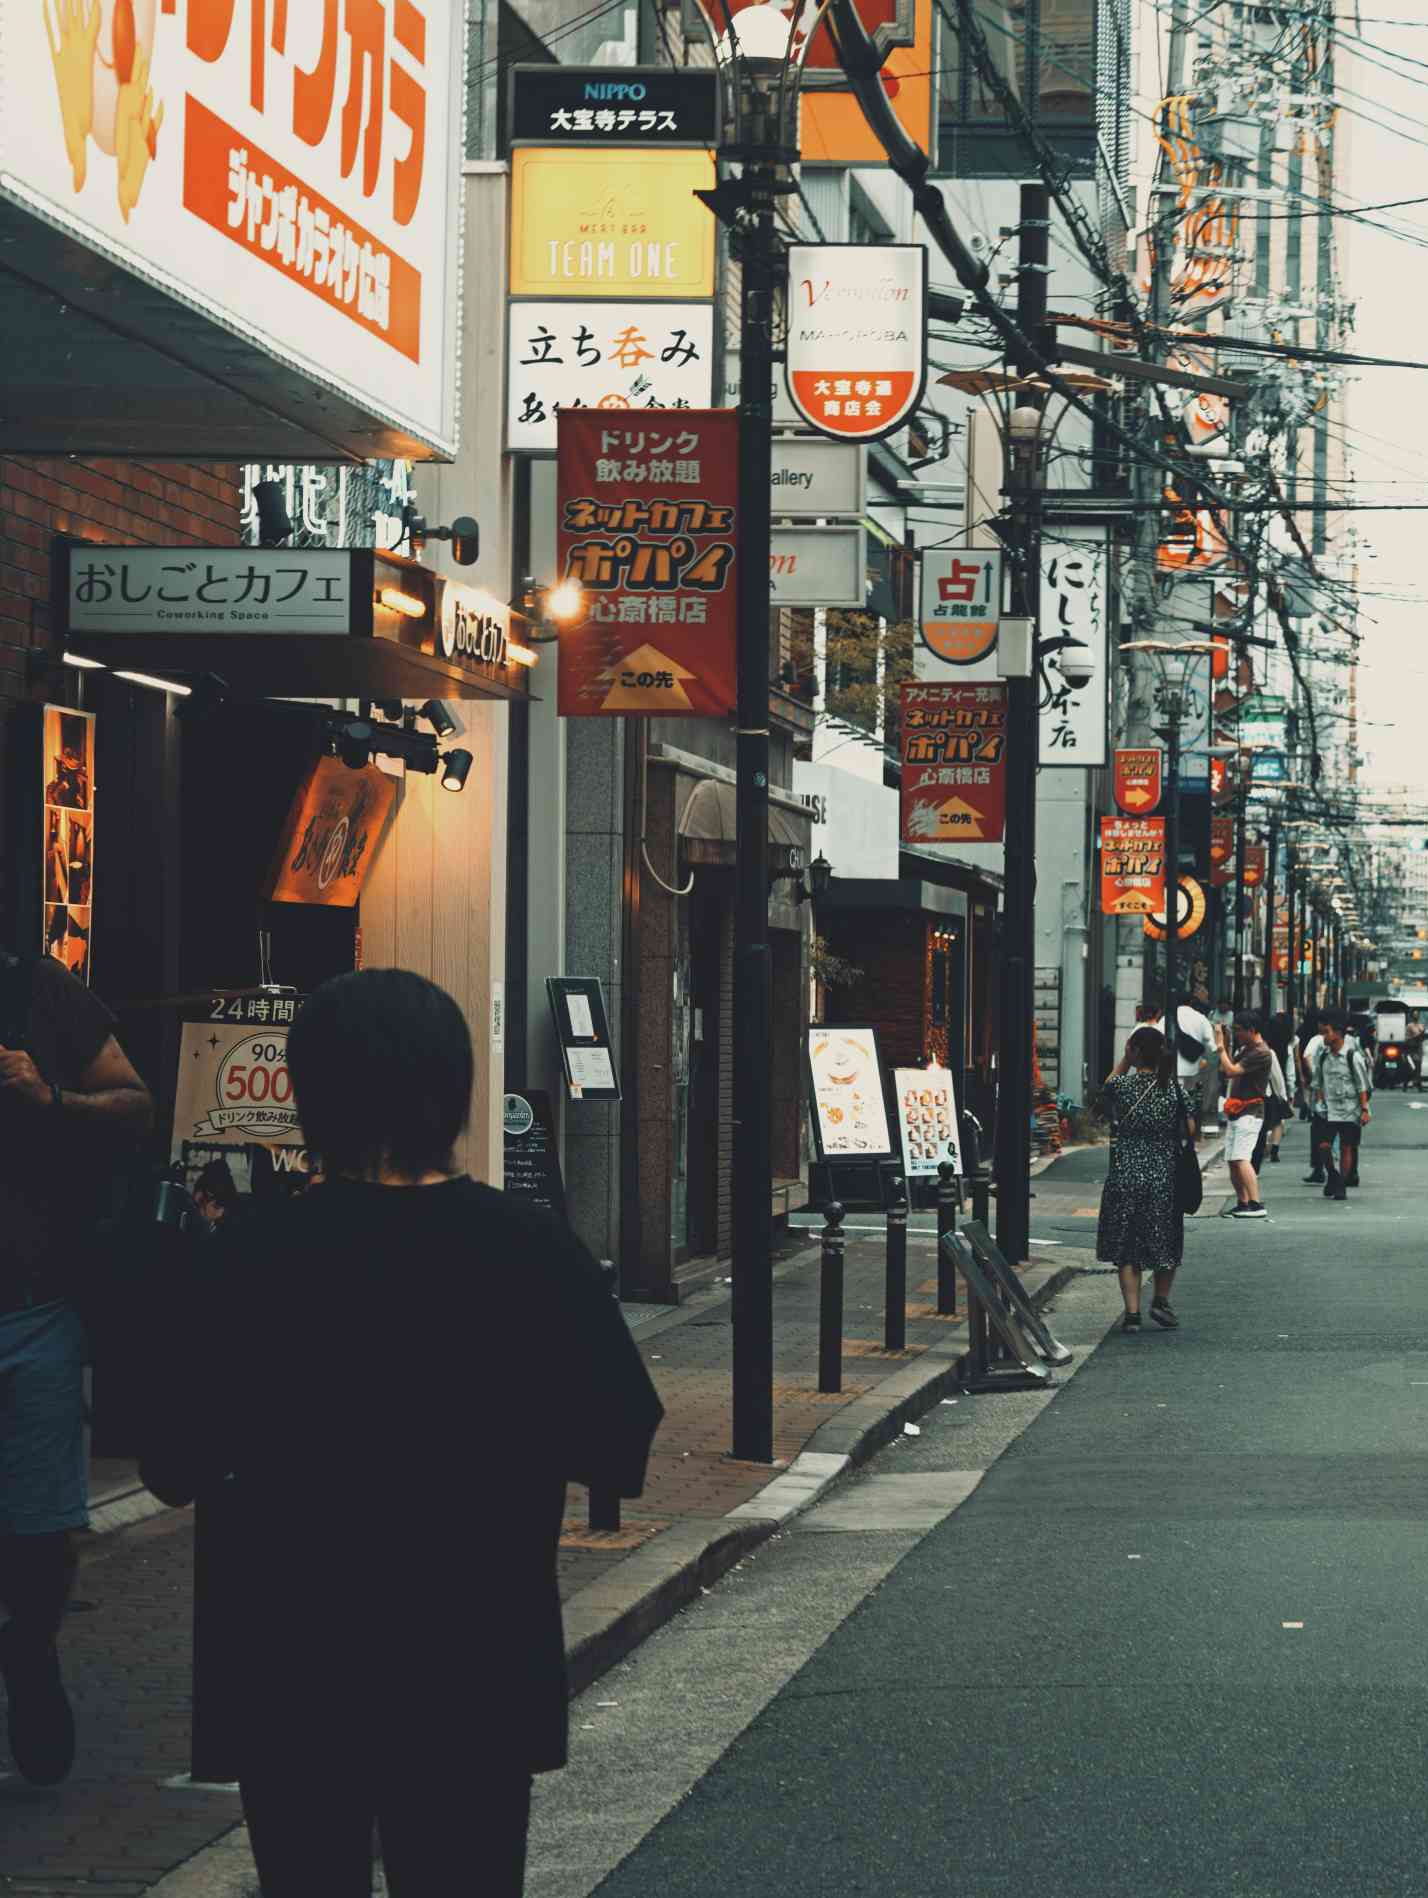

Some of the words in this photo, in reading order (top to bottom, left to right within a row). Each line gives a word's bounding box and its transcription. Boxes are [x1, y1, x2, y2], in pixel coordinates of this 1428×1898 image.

[584, 83, 647, 101] NIPPO
[550, 108, 678, 131] 大宝寺テラス
[548, 239, 615, 280] TEAM
[629, 239, 681, 280] ONE
[519, 325, 701, 368] 立ち呑み
[601, 430, 699, 454] ドリンク
[595, 459, 701, 484] 飲み放題
[770, 468, 813, 489] allery
[564, 499, 735, 534] ネットカフェ
[565, 536, 736, 592] ポパイ
[75, 563, 344, 604] おしごとカフェ
[937, 558, 981, 602] 占
[591, 596, 707, 624] 心斎橋店
[619, 670, 674, 689] この先
[905, 708, 1005, 729] ネットカフェ
[905, 728, 1006, 765] ポパイ
[1103, 855, 1163, 877] ポパイ
[209, 998, 305, 1022] 24時間
